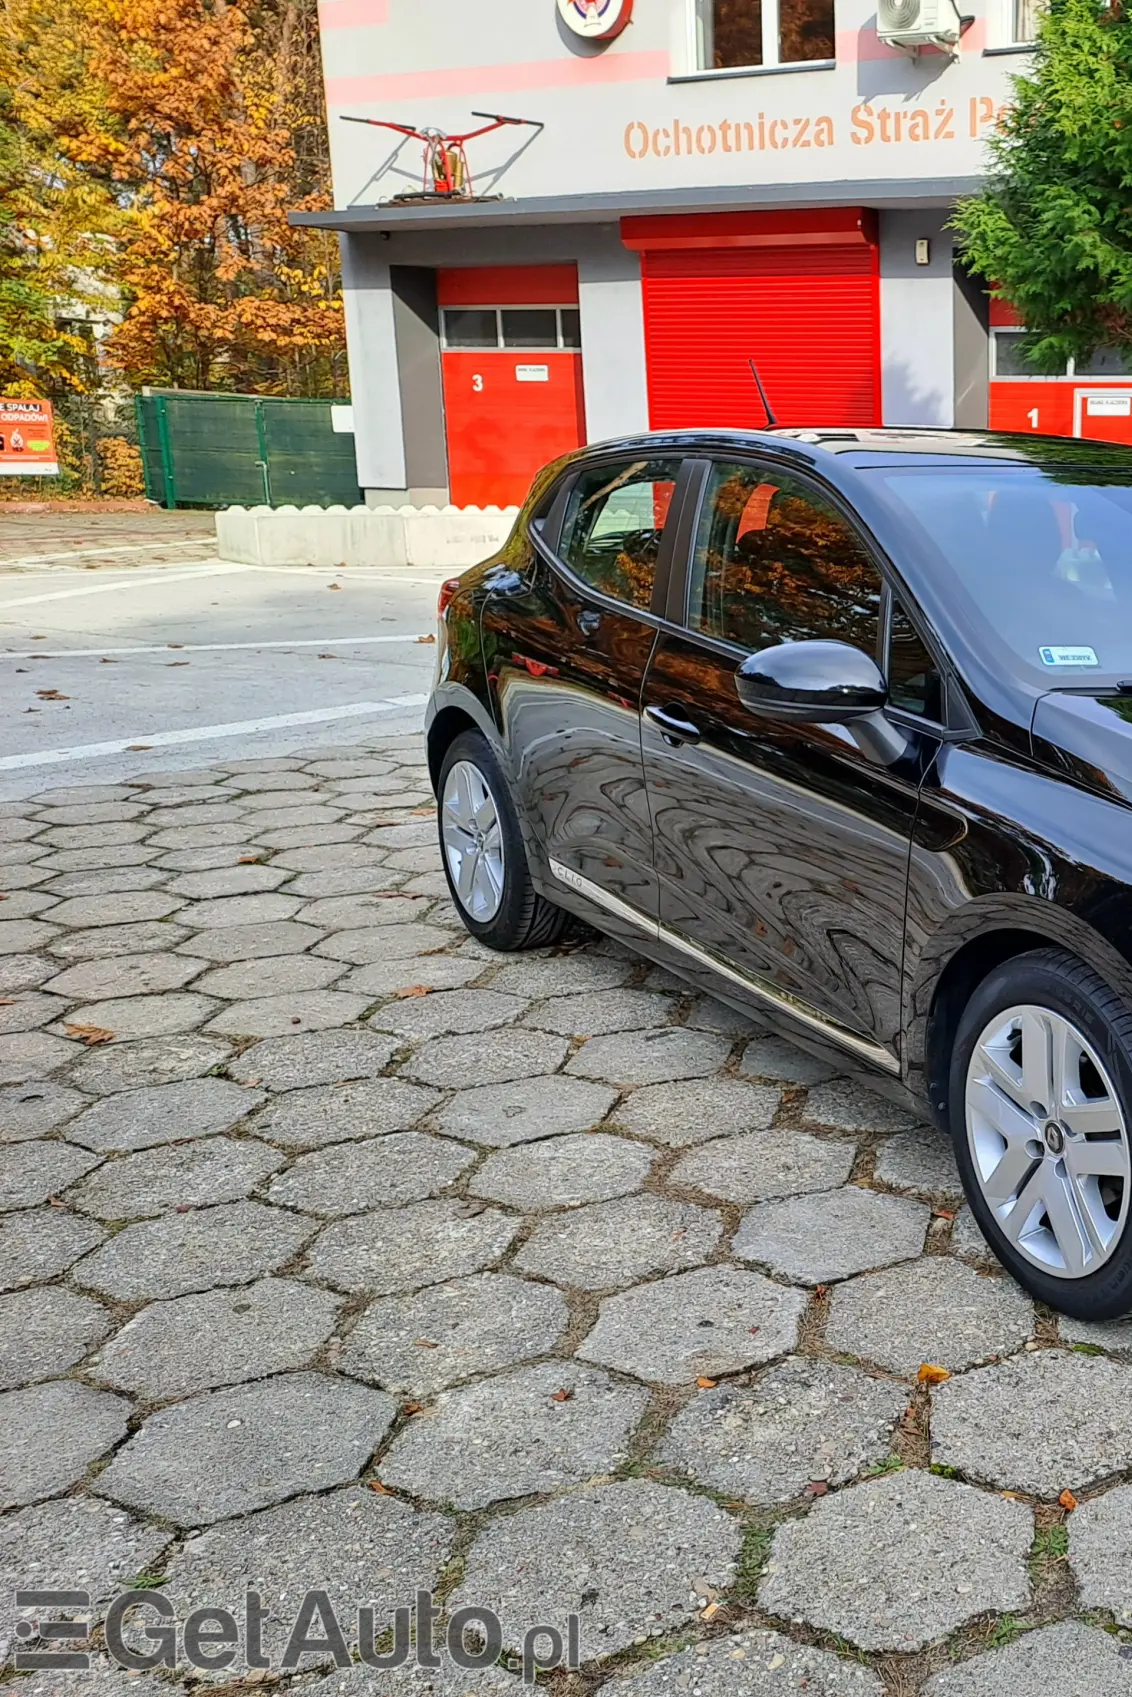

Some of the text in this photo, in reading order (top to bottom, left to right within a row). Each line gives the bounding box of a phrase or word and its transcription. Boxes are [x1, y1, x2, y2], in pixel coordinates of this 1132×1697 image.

[623, 112, 835, 159] Ochotnicza
[849, 98, 955, 145] Straż
[471, 374, 484, 392] 3
[6, 403, 40, 412] SPALAJ
[1027, 408, 1039, 428] 1
[557, 866, 583, 888] CLIO
